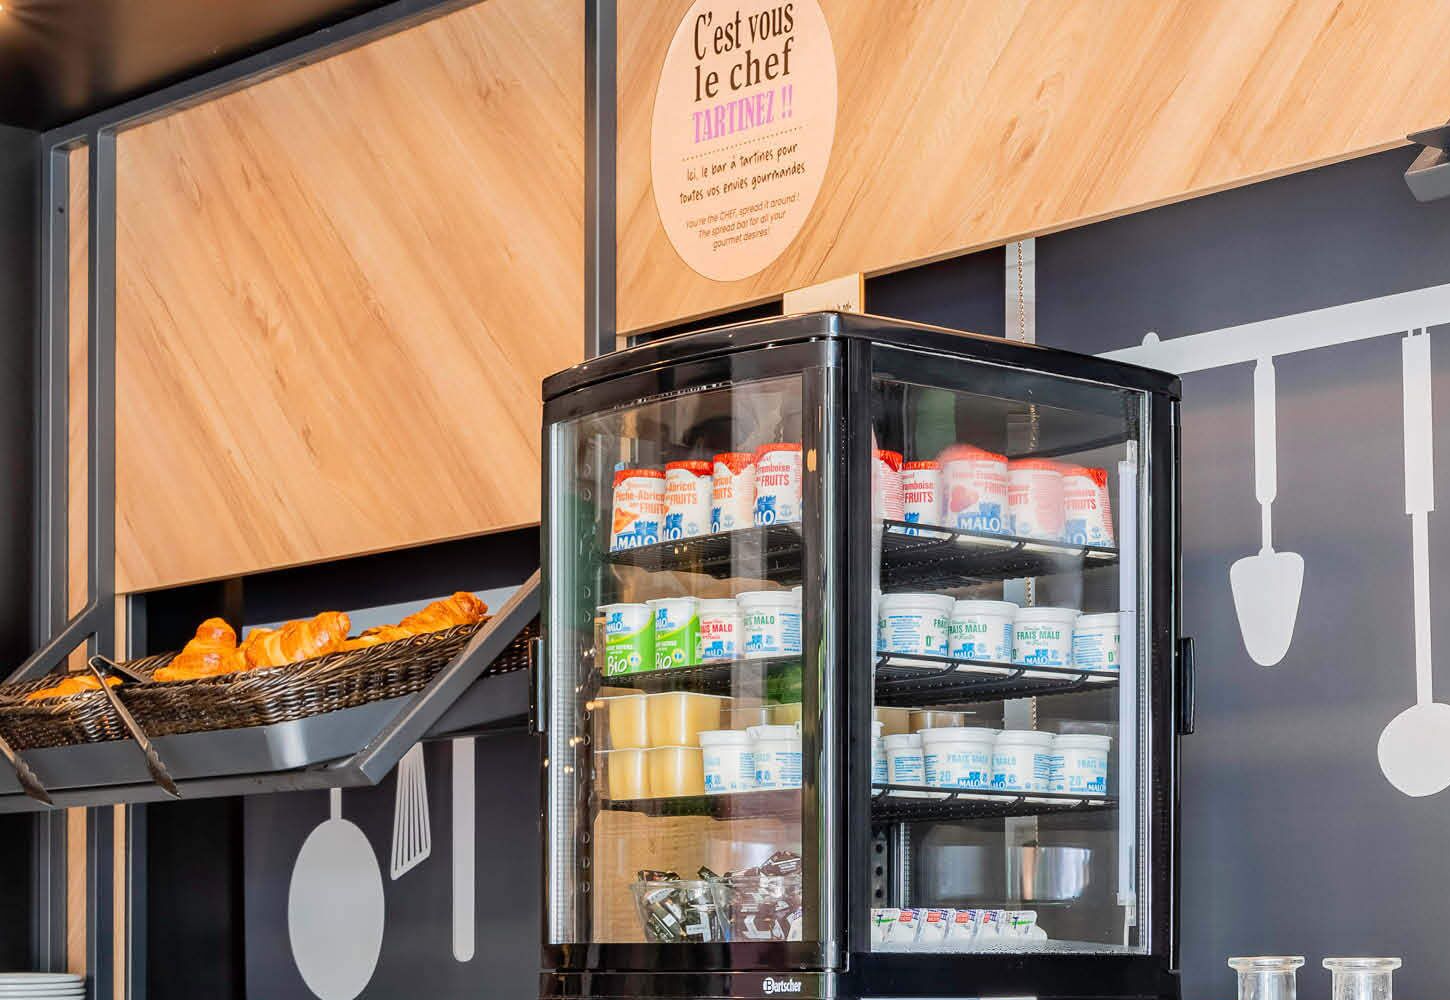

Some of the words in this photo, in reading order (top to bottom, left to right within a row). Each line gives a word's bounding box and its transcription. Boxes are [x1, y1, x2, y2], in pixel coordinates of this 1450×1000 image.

[694, 10, 742, 60] C'est
[748, 3, 794, 43] vous
[695, 64, 719, 102] le
[730, 37, 794, 92] chef
[692, 90, 776, 144] TARTINEZ
[781, 84, 794, 119] !!
[701, 165, 708, 178] le
[711, 161, 727, 175] bar
[739, 149, 774, 167] tartines
[777, 144, 798, 162] pour
[680, 189, 704, 205] toutes
[706, 186, 719, 197] vos
[723, 177, 748, 194] envies
[752, 162, 806, 190] gourmandes
[739, 203, 763, 217] spread
[761, 475, 790, 488] FRUITS
[905, 491, 934, 503] FRUITS
[960, 517, 1000, 531] MALO
[617, 535, 657, 550] MALO
[753, 616, 775, 625] MALO
[712, 624, 733, 632] MALO
[965, 623, 987, 633] MALO
[1017, 631, 1037, 641] FRAIS
[1039, 631, 1060, 640] MALO
[607, 656, 627, 676] Bio
[763, 977, 802, 994] Bartscher
